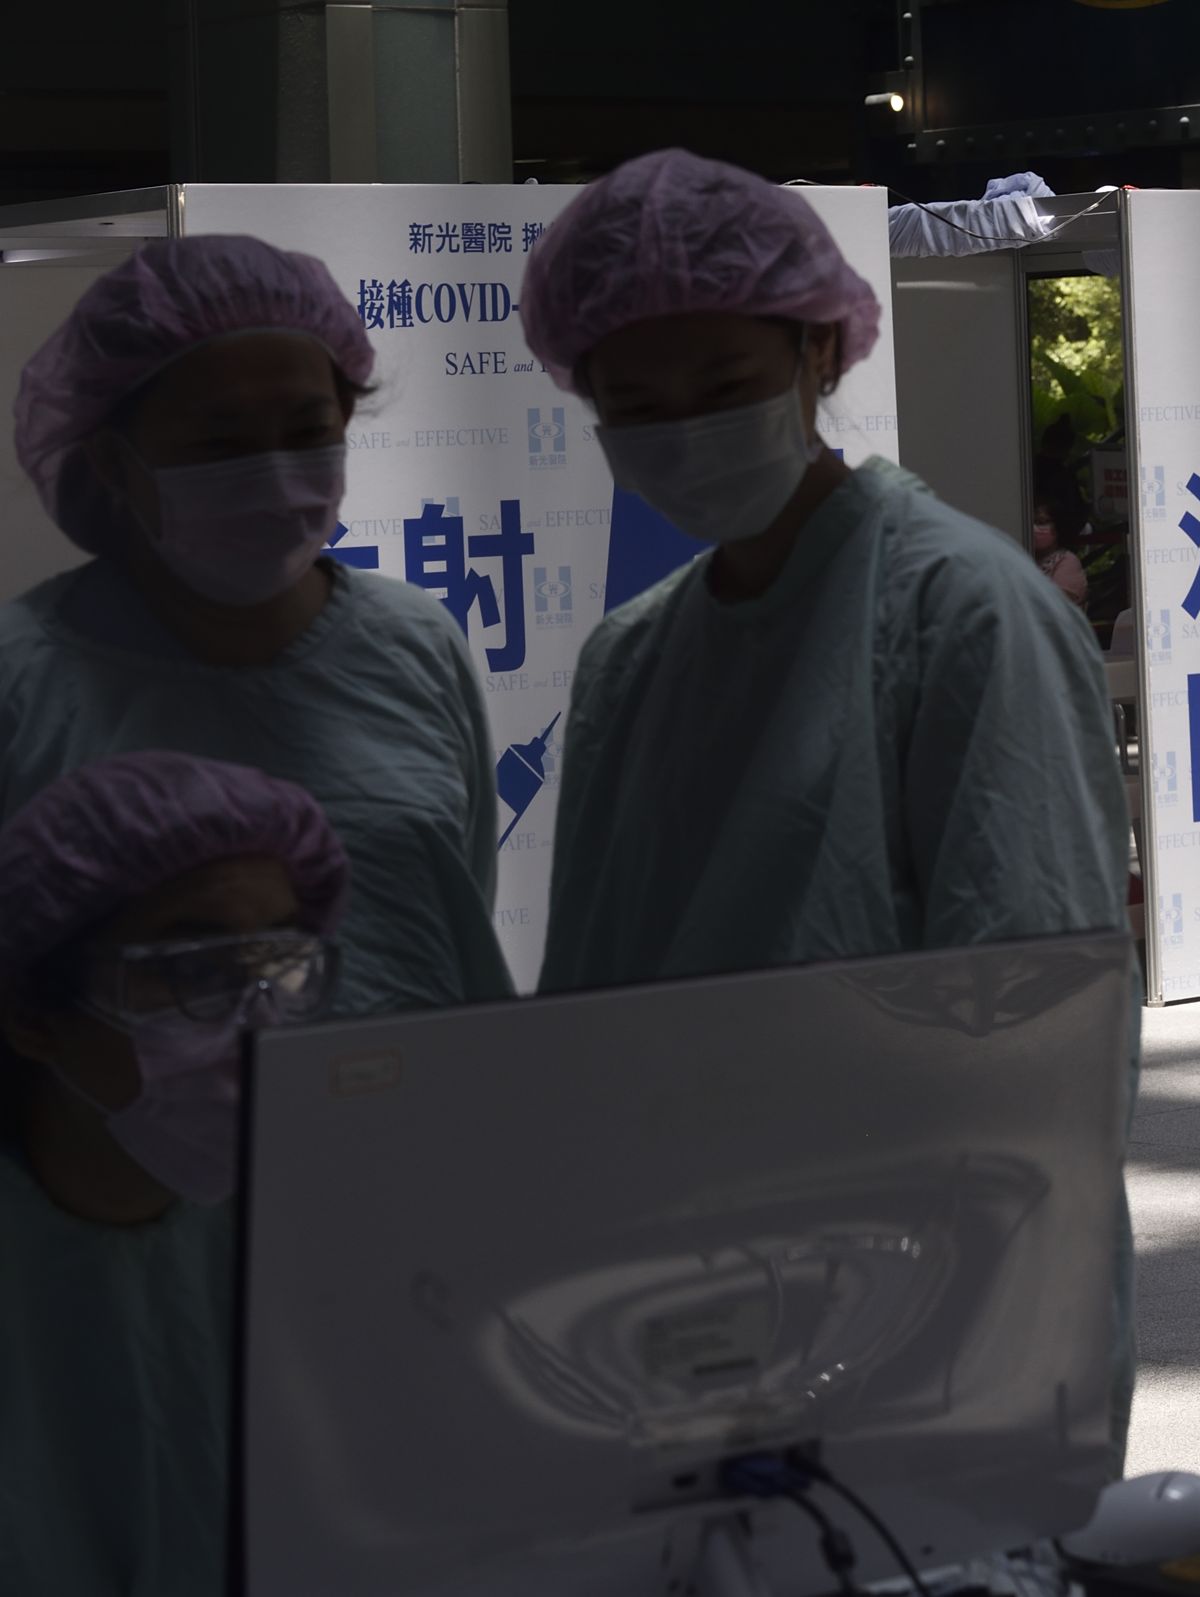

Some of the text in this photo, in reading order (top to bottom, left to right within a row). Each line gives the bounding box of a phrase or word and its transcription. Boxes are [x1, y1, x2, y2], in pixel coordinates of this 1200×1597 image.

[408, 222, 513, 254] 新光醫院
[445, 351, 533, 375] SAFE and
[415, 426, 510, 448] EFFECTIVE
[486, 672, 529, 692] SAFE
